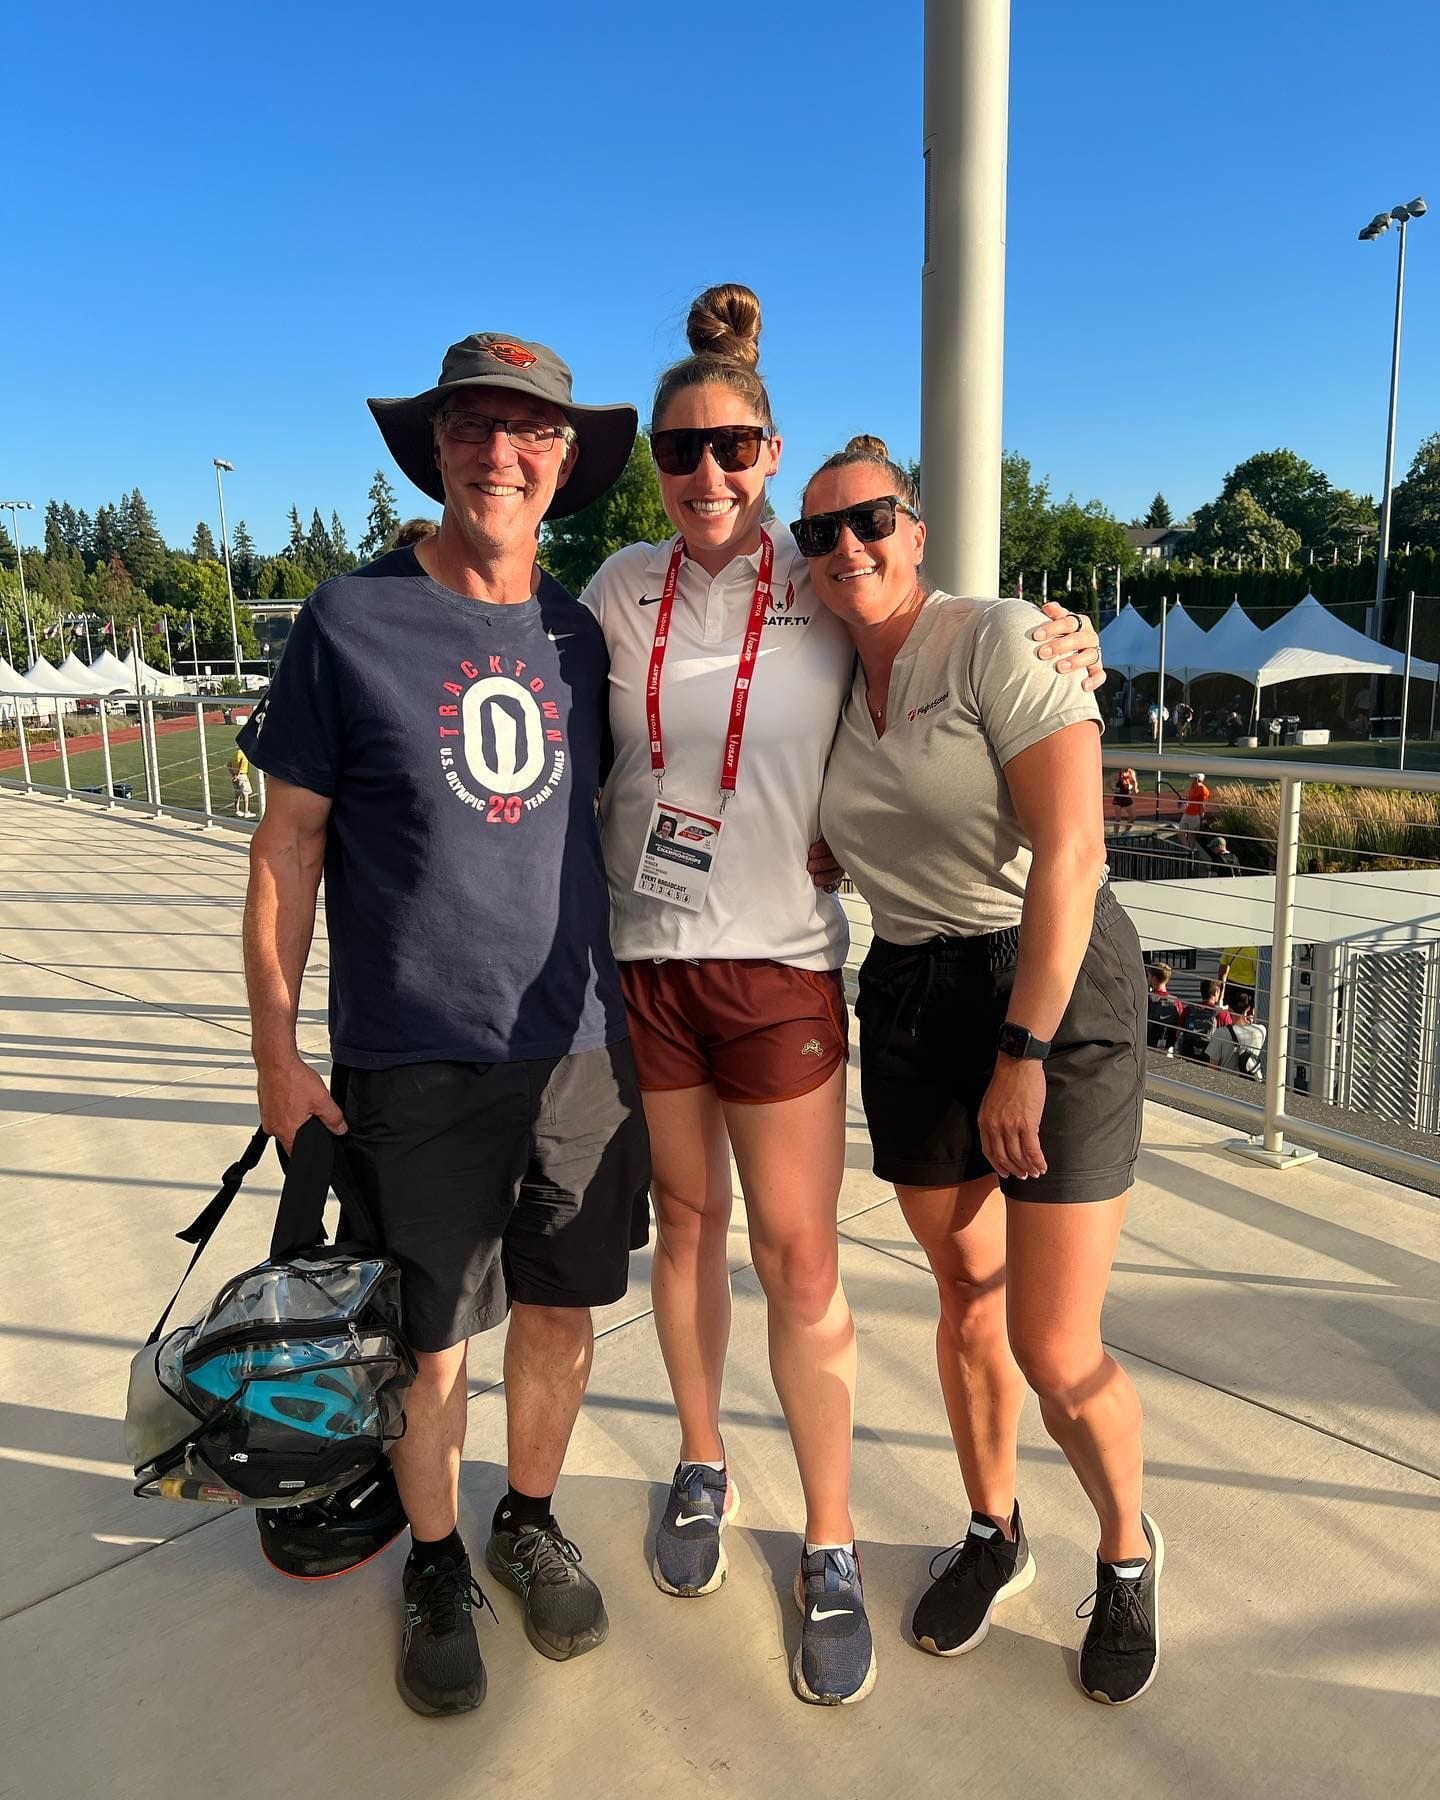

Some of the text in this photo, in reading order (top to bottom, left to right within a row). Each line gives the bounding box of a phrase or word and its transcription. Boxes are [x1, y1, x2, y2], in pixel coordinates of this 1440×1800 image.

[754, 593, 765, 617] TOYOTA
[659, 612, 668, 635] TOYOTA
[762, 616, 811, 626] SATF.TV
[651, 662, 660, 686] USATF
[438, 655, 563, 743] TRACKTOWN
[735, 690, 745, 717] TOYOTA
[650, 713, 658, 739] TOYOTA
[727, 743, 736, 768] USATF
[439, 747, 487, 812] U.S. OLYMPIC
[524, 750, 566, 812] TEAM TRIALS
[485, 795, 523, 824] 20
[641, 873, 687, 893] EVENT BROADCAST
